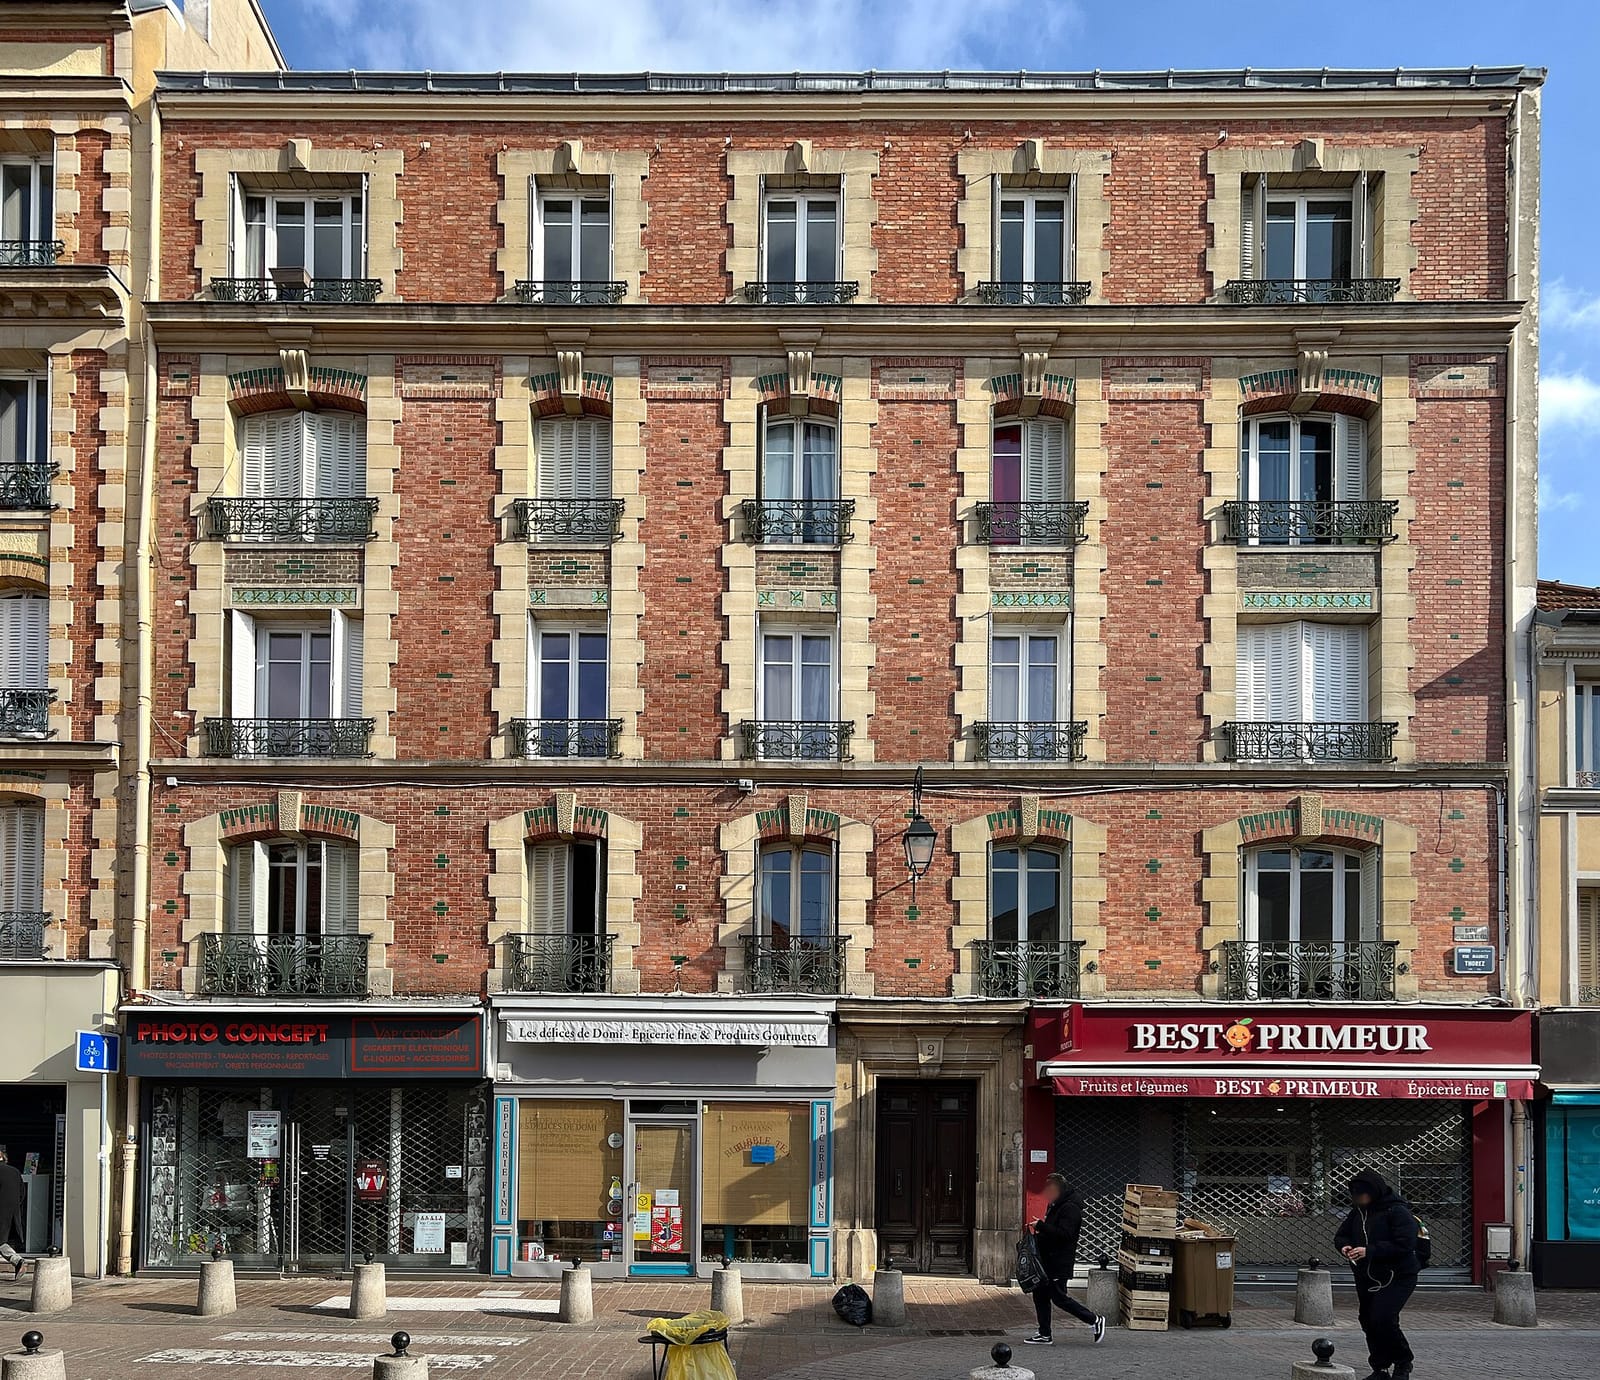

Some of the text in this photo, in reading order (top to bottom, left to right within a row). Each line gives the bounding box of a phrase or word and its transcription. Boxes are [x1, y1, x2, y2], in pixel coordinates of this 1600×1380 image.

[137, 1023, 329, 1042] PHOTO CONCEPT
[519, 1027, 537, 1038] Les
[539, 1027, 575, 1038] délices
[577, 1027, 590, 1039] de
[592, 1028, 623, 1039] Domi
[632, 1028, 674, 1042] Epicerie
[677, 1028, 698, 1040] fine
[699, 1030, 711, 1040] &
[714, 1029, 760, 1041] Produits
[762, 1030, 817, 1041] Gourmets
[1133, 1023, 1433, 1050] BEST PRIMEUR
[362, 1044, 406, 1052] CIGARETTE
[927, 1044, 935, 1056] 2
[414, 1055, 470, 1063] ACCESSOIRES
[1079, 1080, 1189, 1095] Fruits et légumes
[1214, 1080, 1381, 1096] BEST PRIMEUR
[1407, 1080, 1490, 1097] Épicerie fine
